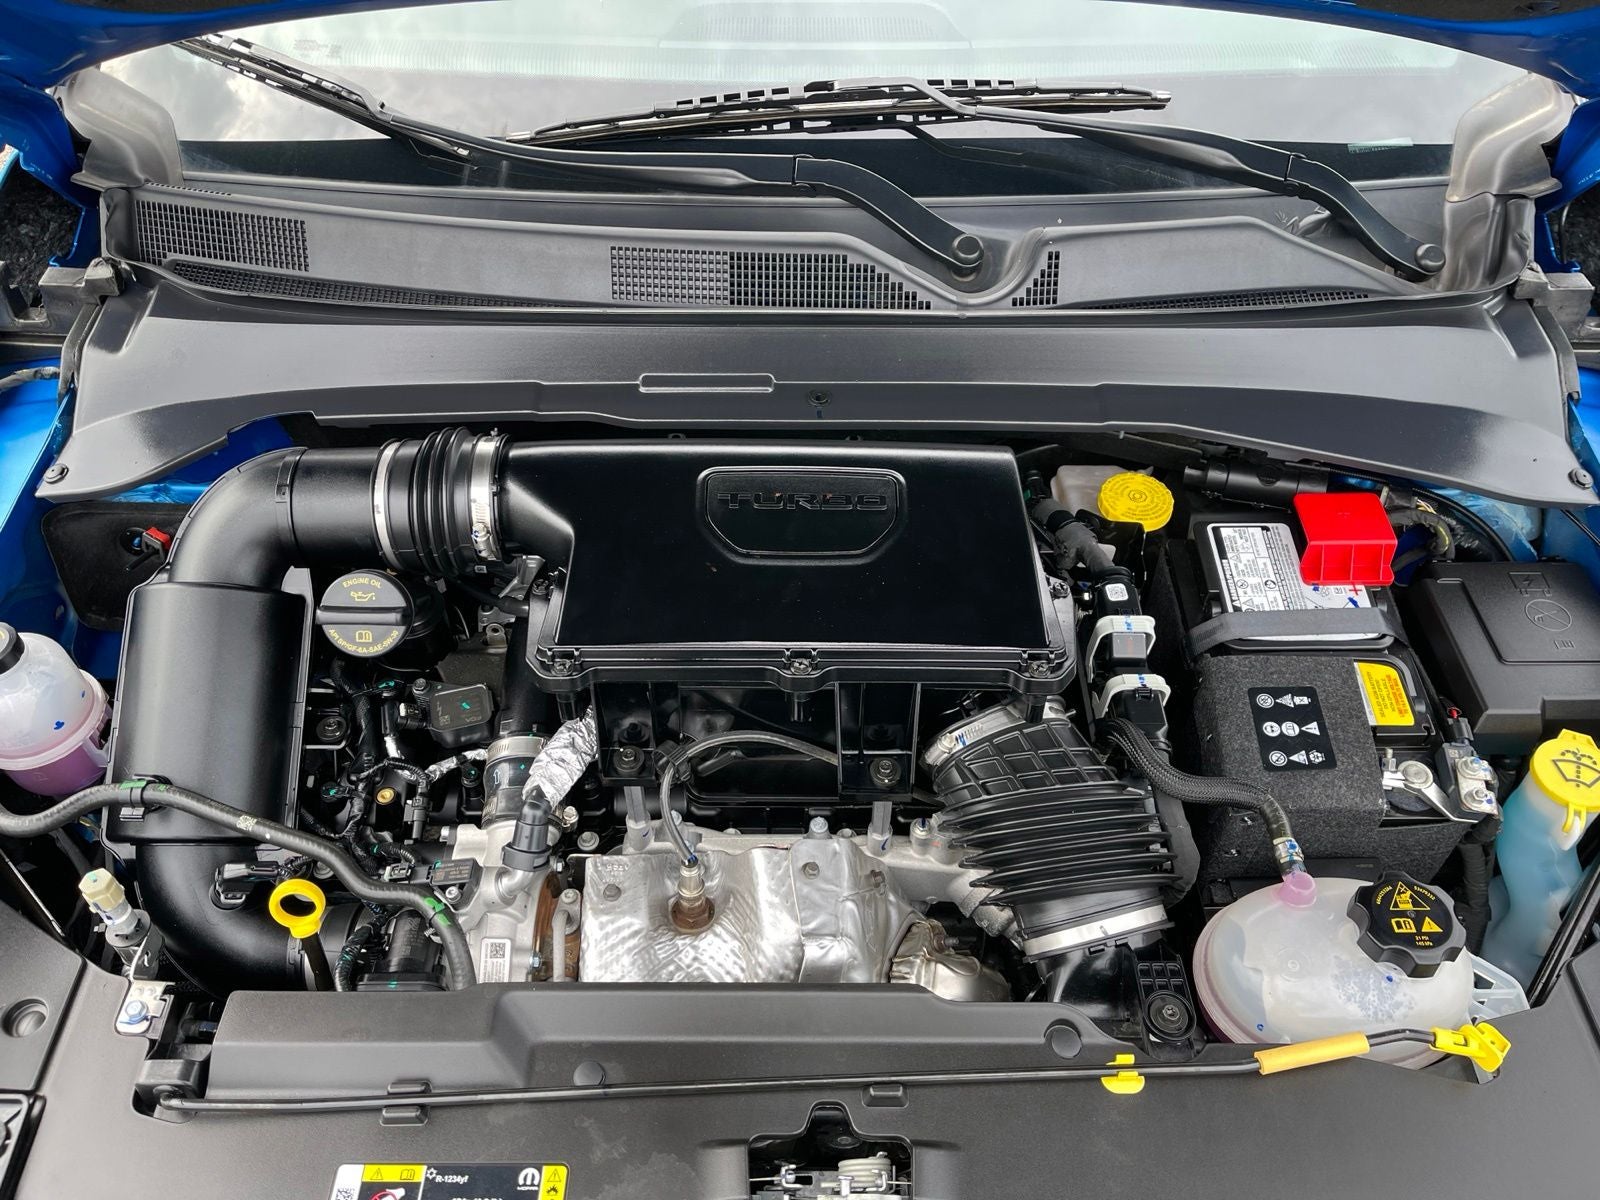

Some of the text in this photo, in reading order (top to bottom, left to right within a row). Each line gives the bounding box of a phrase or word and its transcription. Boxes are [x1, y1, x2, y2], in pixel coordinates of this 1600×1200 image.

[718, 493, 888, 510] TURBO
[342, 577, 383, 589] ENGINE OIL
[329, 629, 339, 641] API
[435, 1175, 469, 1184] R-1234yf
